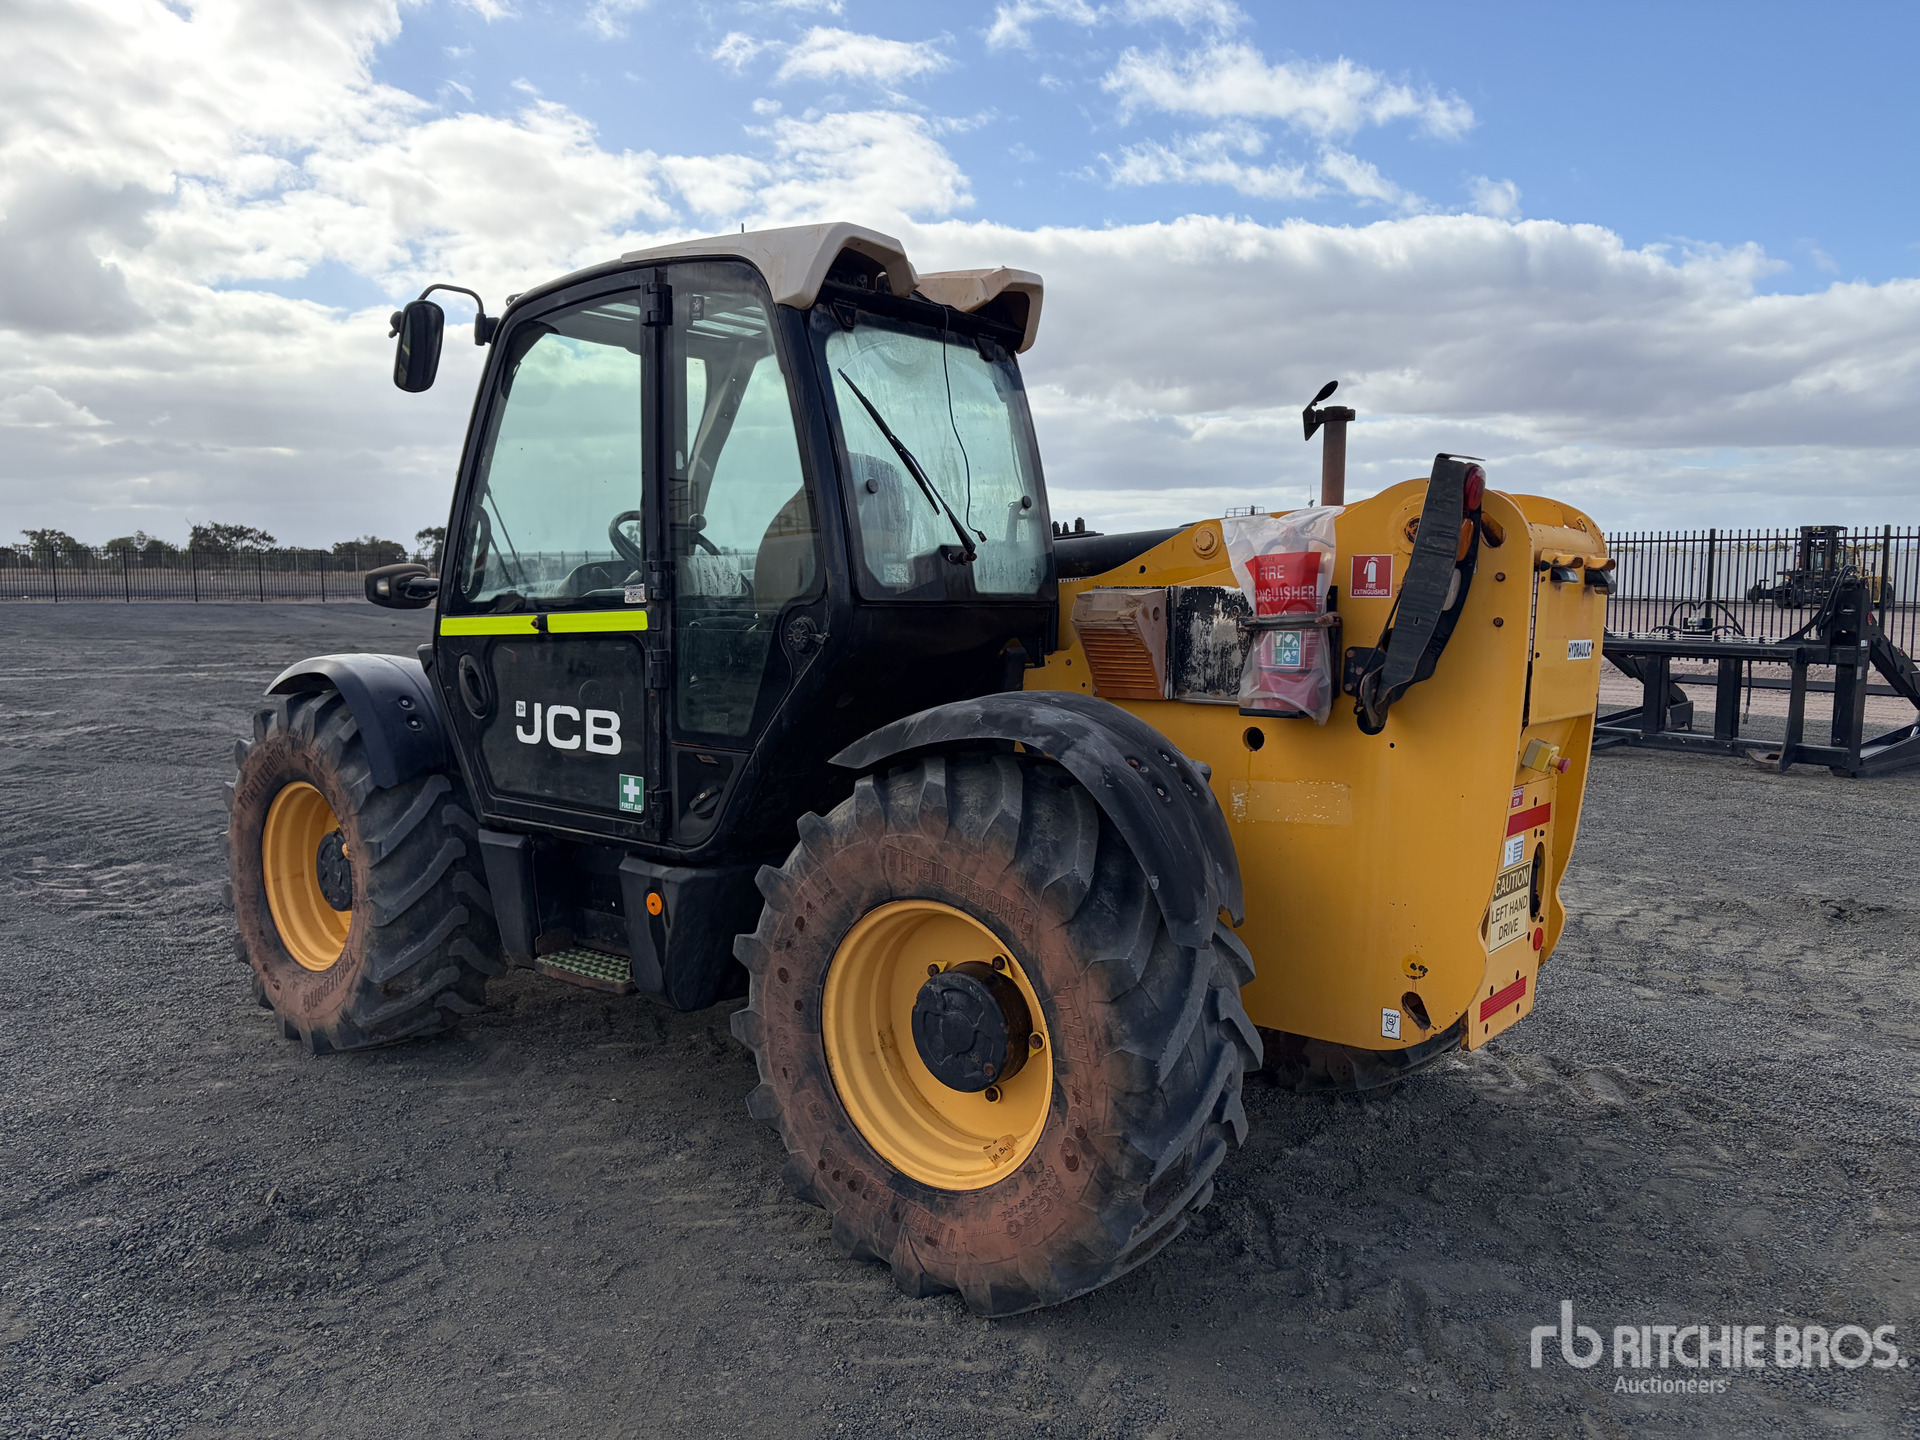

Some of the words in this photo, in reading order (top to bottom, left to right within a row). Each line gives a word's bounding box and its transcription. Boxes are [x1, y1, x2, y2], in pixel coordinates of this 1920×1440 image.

[1259, 565, 1285, 580] FIRE
[1568, 642, 1591, 658] HYDRAULIC
[516, 702, 622, 755] JCB
[621, 801, 634, 810] FIRST
[884, 842, 1035, 934] TRELLEBORG
[1495, 867, 1529, 897] CAUTION
[1492, 904, 1508, 924] LEFT
[1509, 895, 1528, 916] HAND
[1499, 917, 1519, 941] DRIVE
